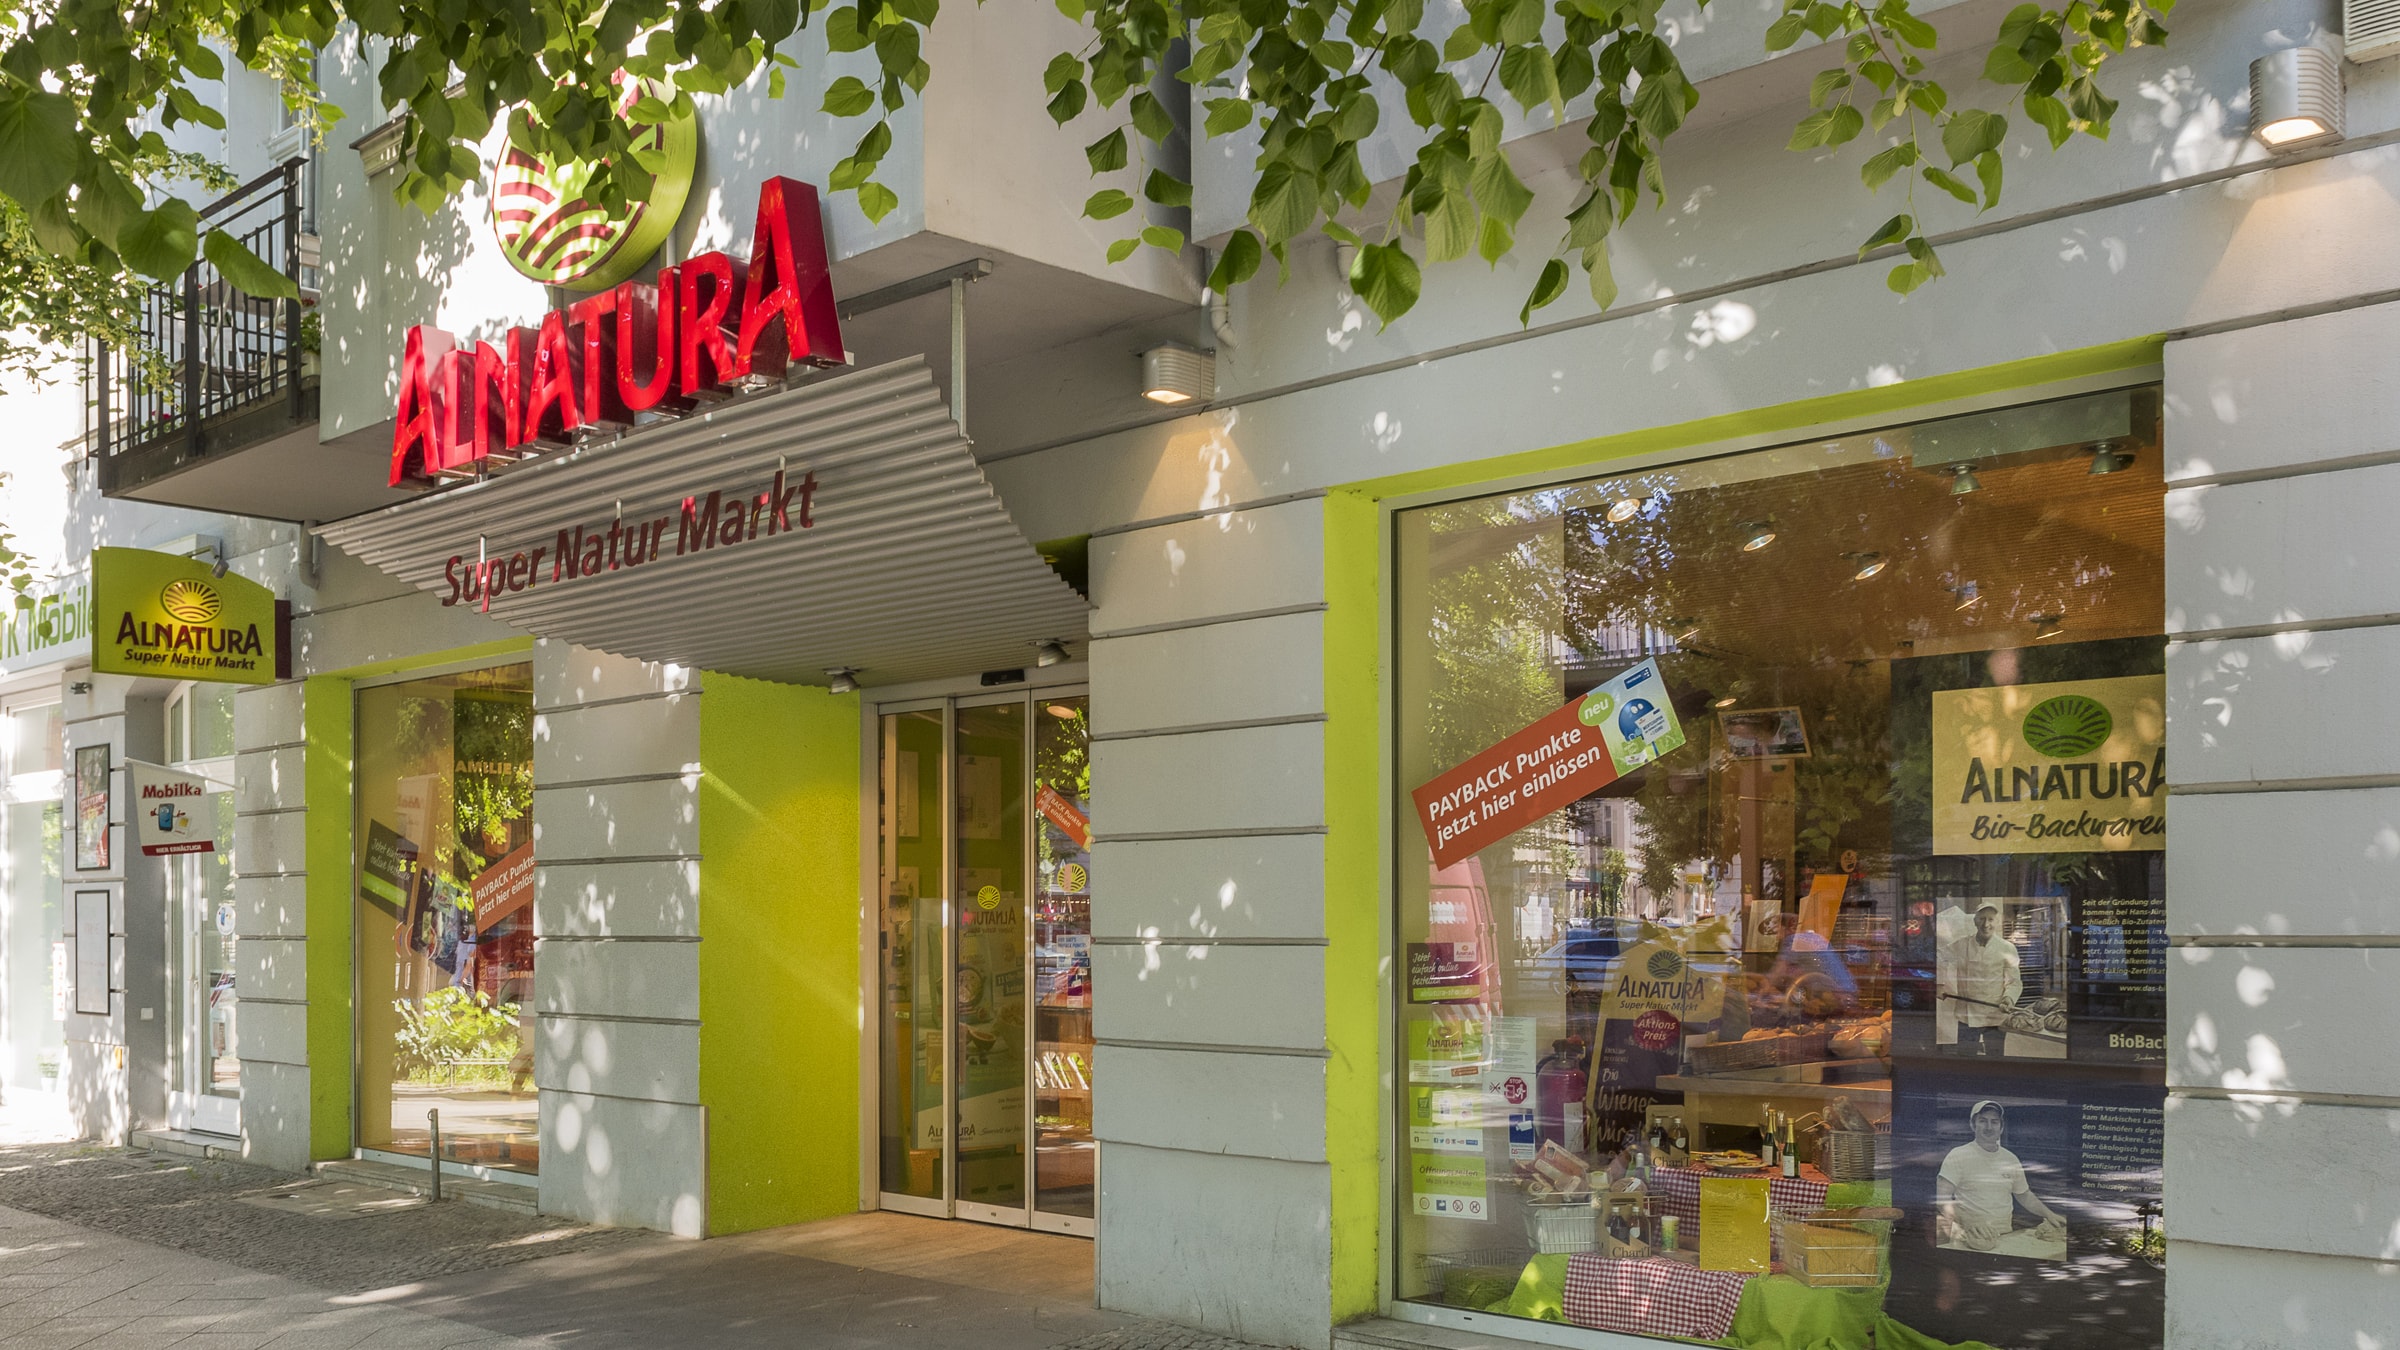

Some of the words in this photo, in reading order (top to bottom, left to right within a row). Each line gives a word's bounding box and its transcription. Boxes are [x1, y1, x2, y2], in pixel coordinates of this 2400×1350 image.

[387, 175, 845, 488] ALNATURA
[442, 554, 546, 612] Super
[551, 516, 669, 584] Natur
[676, 470, 818, 556] Markt
[116, 611, 264, 657] ALNATURA
[124, 648, 168, 664] Super
[171, 653, 213, 668] Natur
[215, 656, 256, 671] Markt
[1584, 698, 1609, 720] neu
[1429, 762, 1512, 822] PAYBACK
[1516, 727, 1582, 775] Punkte
[1961, 747, 2166, 804] ALNATURA
[142, 782, 203, 799] Mobilka
[1437, 813, 1478, 850] jetzt
[1482, 789, 1517, 821] hier
[1522, 746, 1601, 798] einlösen
[1042, 790, 1066, 812] PABACK
[1064, 809, 1082, 828] Punkte
[1050, 808, 1071, 828] einlösen
[476, 871, 508, 903] PAYBACK
[510, 856, 535, 880] Punkte
[479, 898, 495, 921] jetzt
[496, 889, 510, 906] hier
[2112, 898, 2148, 907] Gründung
[1413, 952, 1431, 962] Jetzt
[1412, 962, 1436, 974] einfach
[1438, 962, 1459, 972] online
[1617, 975, 1705, 1000] ALNATURA
[1619, 1000, 1645, 1010] Super
[1646, 1001, 1669, 1010] Natur
[1672, 1002, 1698, 1012] Markt
[1638, 1018, 1676, 1030] Aktions
[1426, 1037, 1464, 1048] ALNATURA
[1642, 1030, 1667, 1041] Preis
[1597, 1086, 1658, 1113] Wiener
[2100, 1114, 2140, 1123] Märkisches
[2098, 1124, 2133, 1132] Steinöfen
[2135, 1126, 2148, 1134] der
[2099, 1143, 2138, 1153] ökologisch
[2112, 1134, 2145, 1143] Bäckerei.
[2148, 1137, 2162, 1145] Seit
[2082, 1152, 2111, 1160] Pioniere
[2113, 1154, 2128, 1162] sind
[2125, 1165, 2139, 1173] Das
